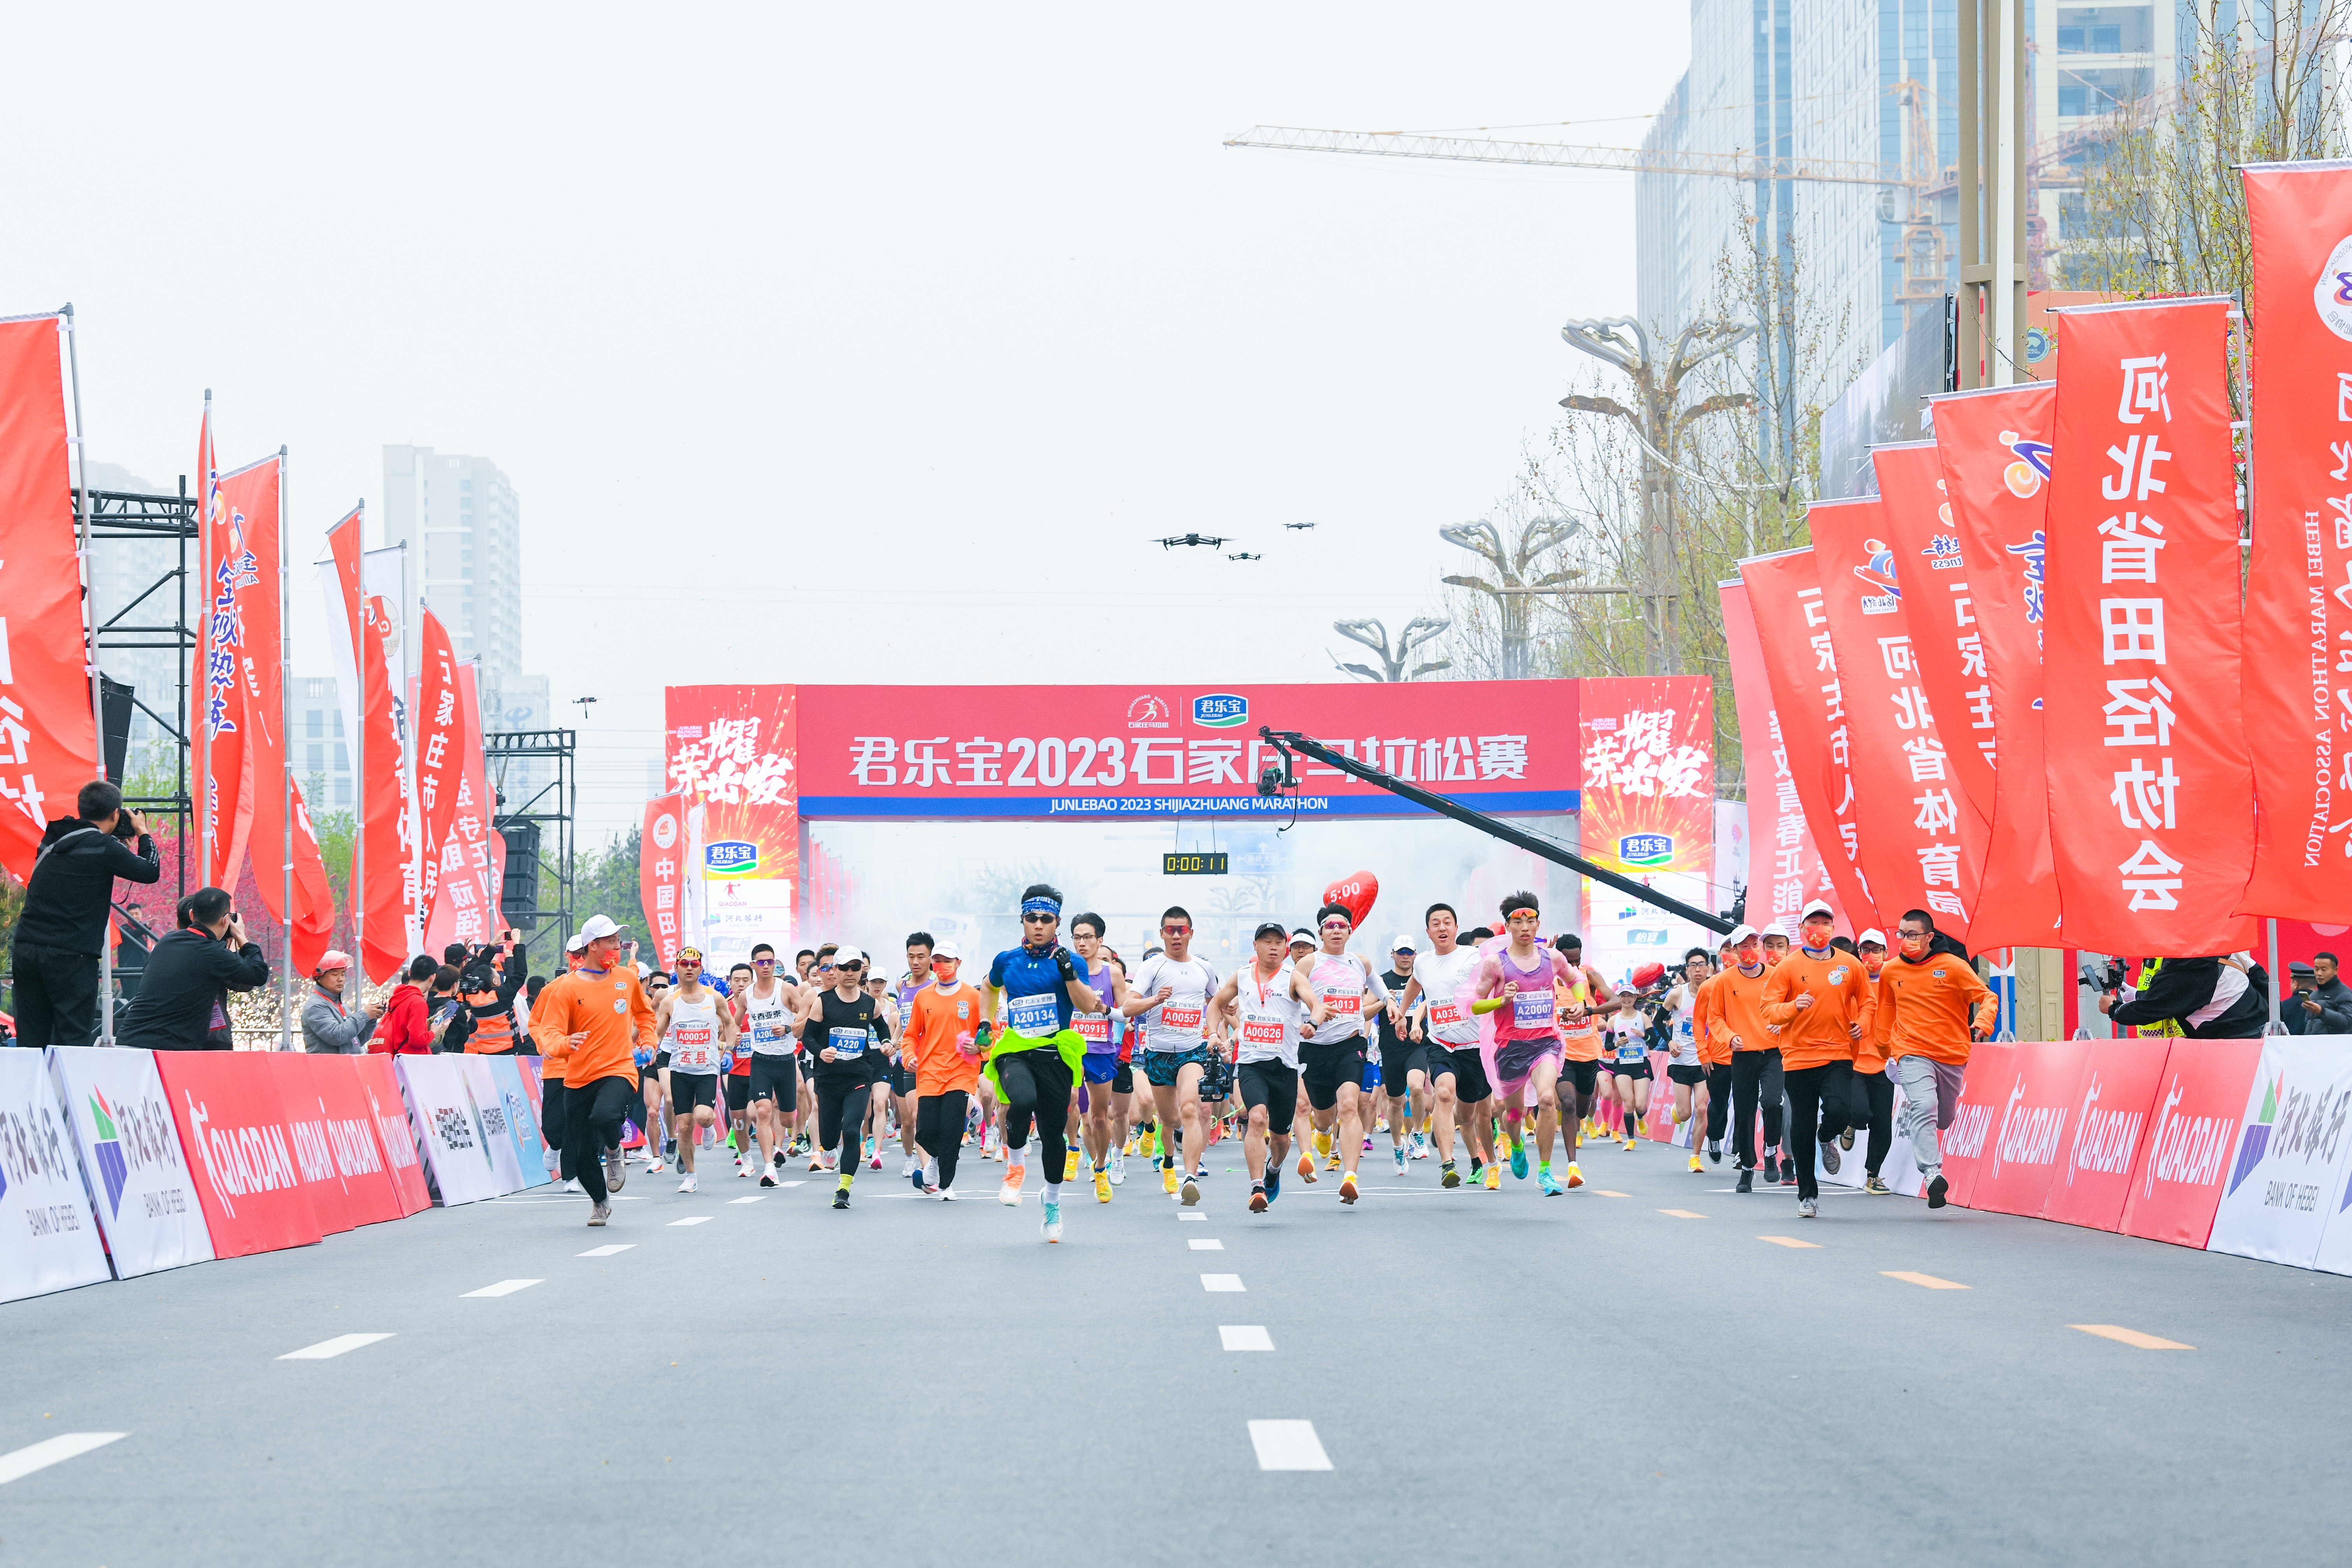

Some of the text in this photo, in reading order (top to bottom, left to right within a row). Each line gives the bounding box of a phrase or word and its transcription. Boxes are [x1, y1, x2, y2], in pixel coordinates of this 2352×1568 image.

[1127, 694, 1169, 718] SHIJIAZHUANG MARATHON
[1201, 699, 1241, 713] 君乐宝
[1050, 797, 1327, 813] JUNLEBAO 2023 SHIJIAZHUANG MARATHON
[1626, 838, 1667, 852] 君乐宝
[711, 846, 751, 859] 君乐宝
[1167, 857, 1224, 871] 0:00:11
[1330, 882, 1360, 903] 5:00
[725, 914, 762, 922] 河北银行
[1436, 1008, 1458, 1020] A035
[1517, 1003, 1552, 1015] A20007
[1014, 1008, 1055, 1025] A20134
[1164, 1012, 1200, 1024] A00557
[756, 1029, 774, 1040] A200
[1073, 1024, 1106, 1033] A90915
[1245, 1026, 1281, 1039] A00626
[678, 1032, 709, 1041] A00034
[836, 1039, 859, 1049] A220
[1946, 1102, 1995, 1159] QIAODAN
[2272, 1083, 2351, 1167] 河北银行
[2003, 1105, 2068, 1165] QIAODAN
[2078, 1107, 2143, 1175] QIAODAN
[2157, 1112, 2234, 1186] QIAODAN
[210, 1124, 298, 1197] QIAODAN
[2264, 1181, 2320, 1212] BANK OF HEBEI
